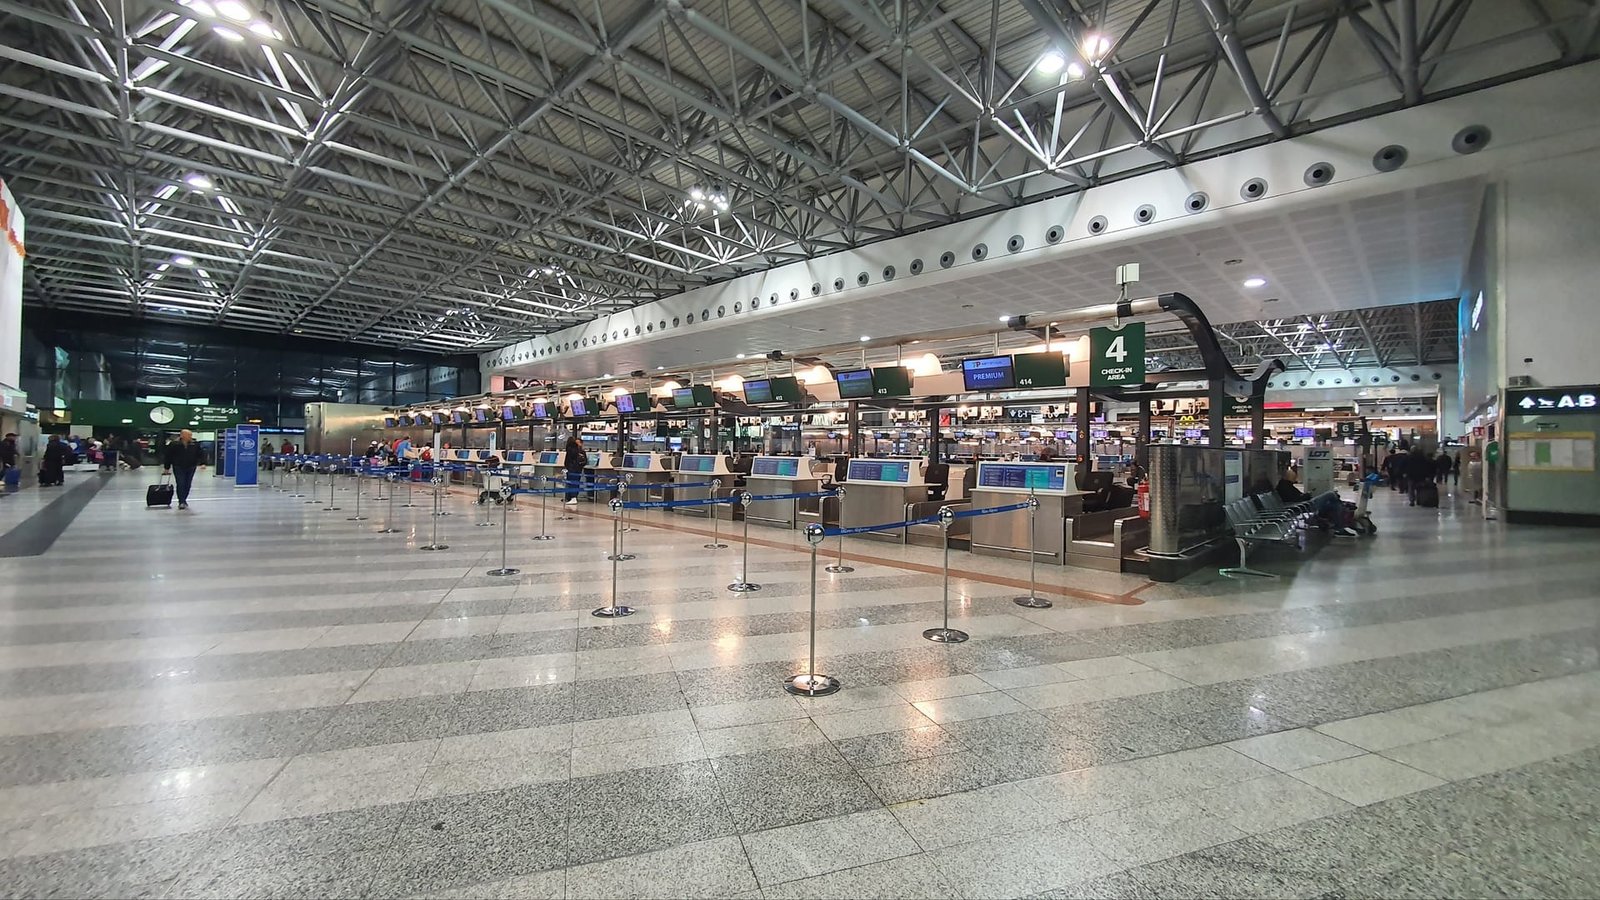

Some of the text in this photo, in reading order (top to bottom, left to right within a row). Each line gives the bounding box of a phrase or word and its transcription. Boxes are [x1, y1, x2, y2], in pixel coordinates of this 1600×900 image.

[1105, 336, 1128, 363] 4
[1101, 367, 1133, 375] CHECK-IN
[973, 371, 1005, 380] PREMIUM
[1019, 378, 1033, 386] 414
